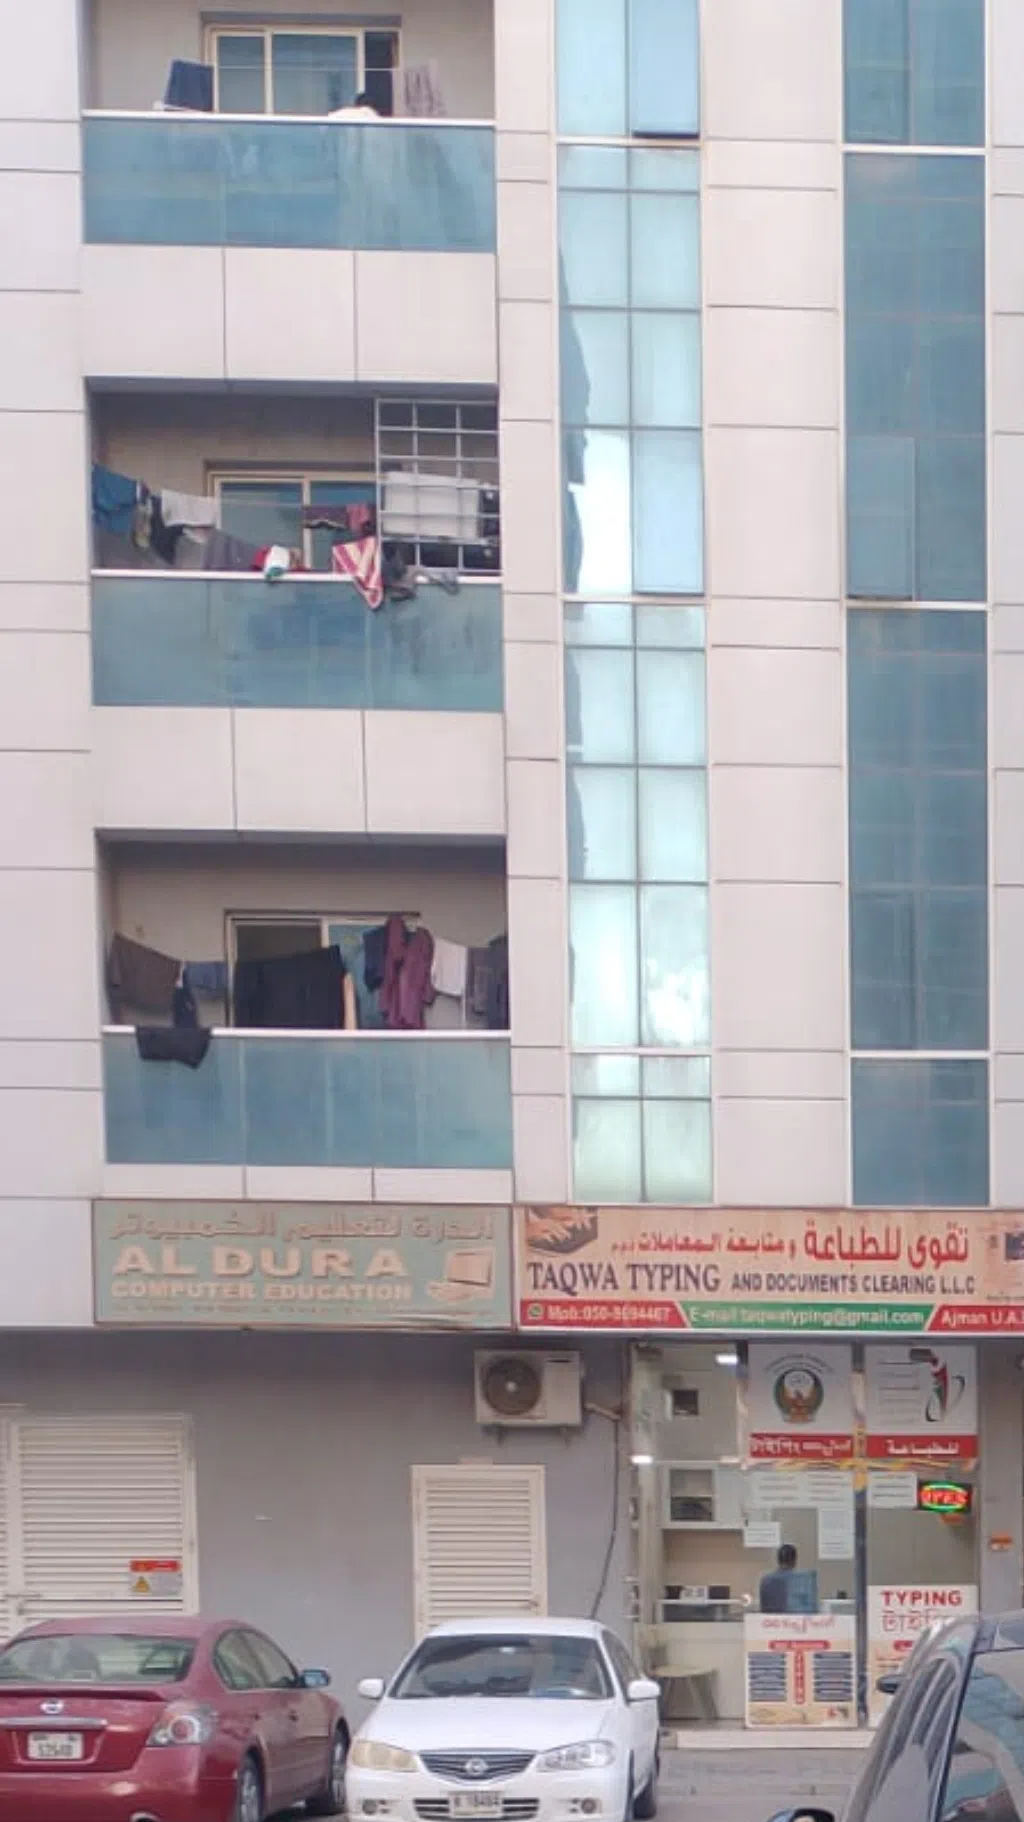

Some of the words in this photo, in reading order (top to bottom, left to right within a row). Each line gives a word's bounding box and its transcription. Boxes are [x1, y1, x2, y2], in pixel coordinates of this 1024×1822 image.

[804, 1218, 901, 1267] للطباعة
[907, 1221, 968, 1269] تقوى
[113, 1245, 197, 1276] AL
[212, 1245, 407, 1278] DURA
[111, 1282, 256, 1300] COMPUTER
[264, 1282, 414, 1302] EDUCATION
[527, 1262, 619, 1296] TAQWA
[626, 1264, 721, 1293] TYPING
[732, 1272, 762, 1291] AND
[767, 1273, 858, 1293] DOCUMENTS
[862, 1275, 937, 1294] CLEARING
[942, 1310, 988, 1327] Ajman
[881, 1591, 963, 1606] TYPING
